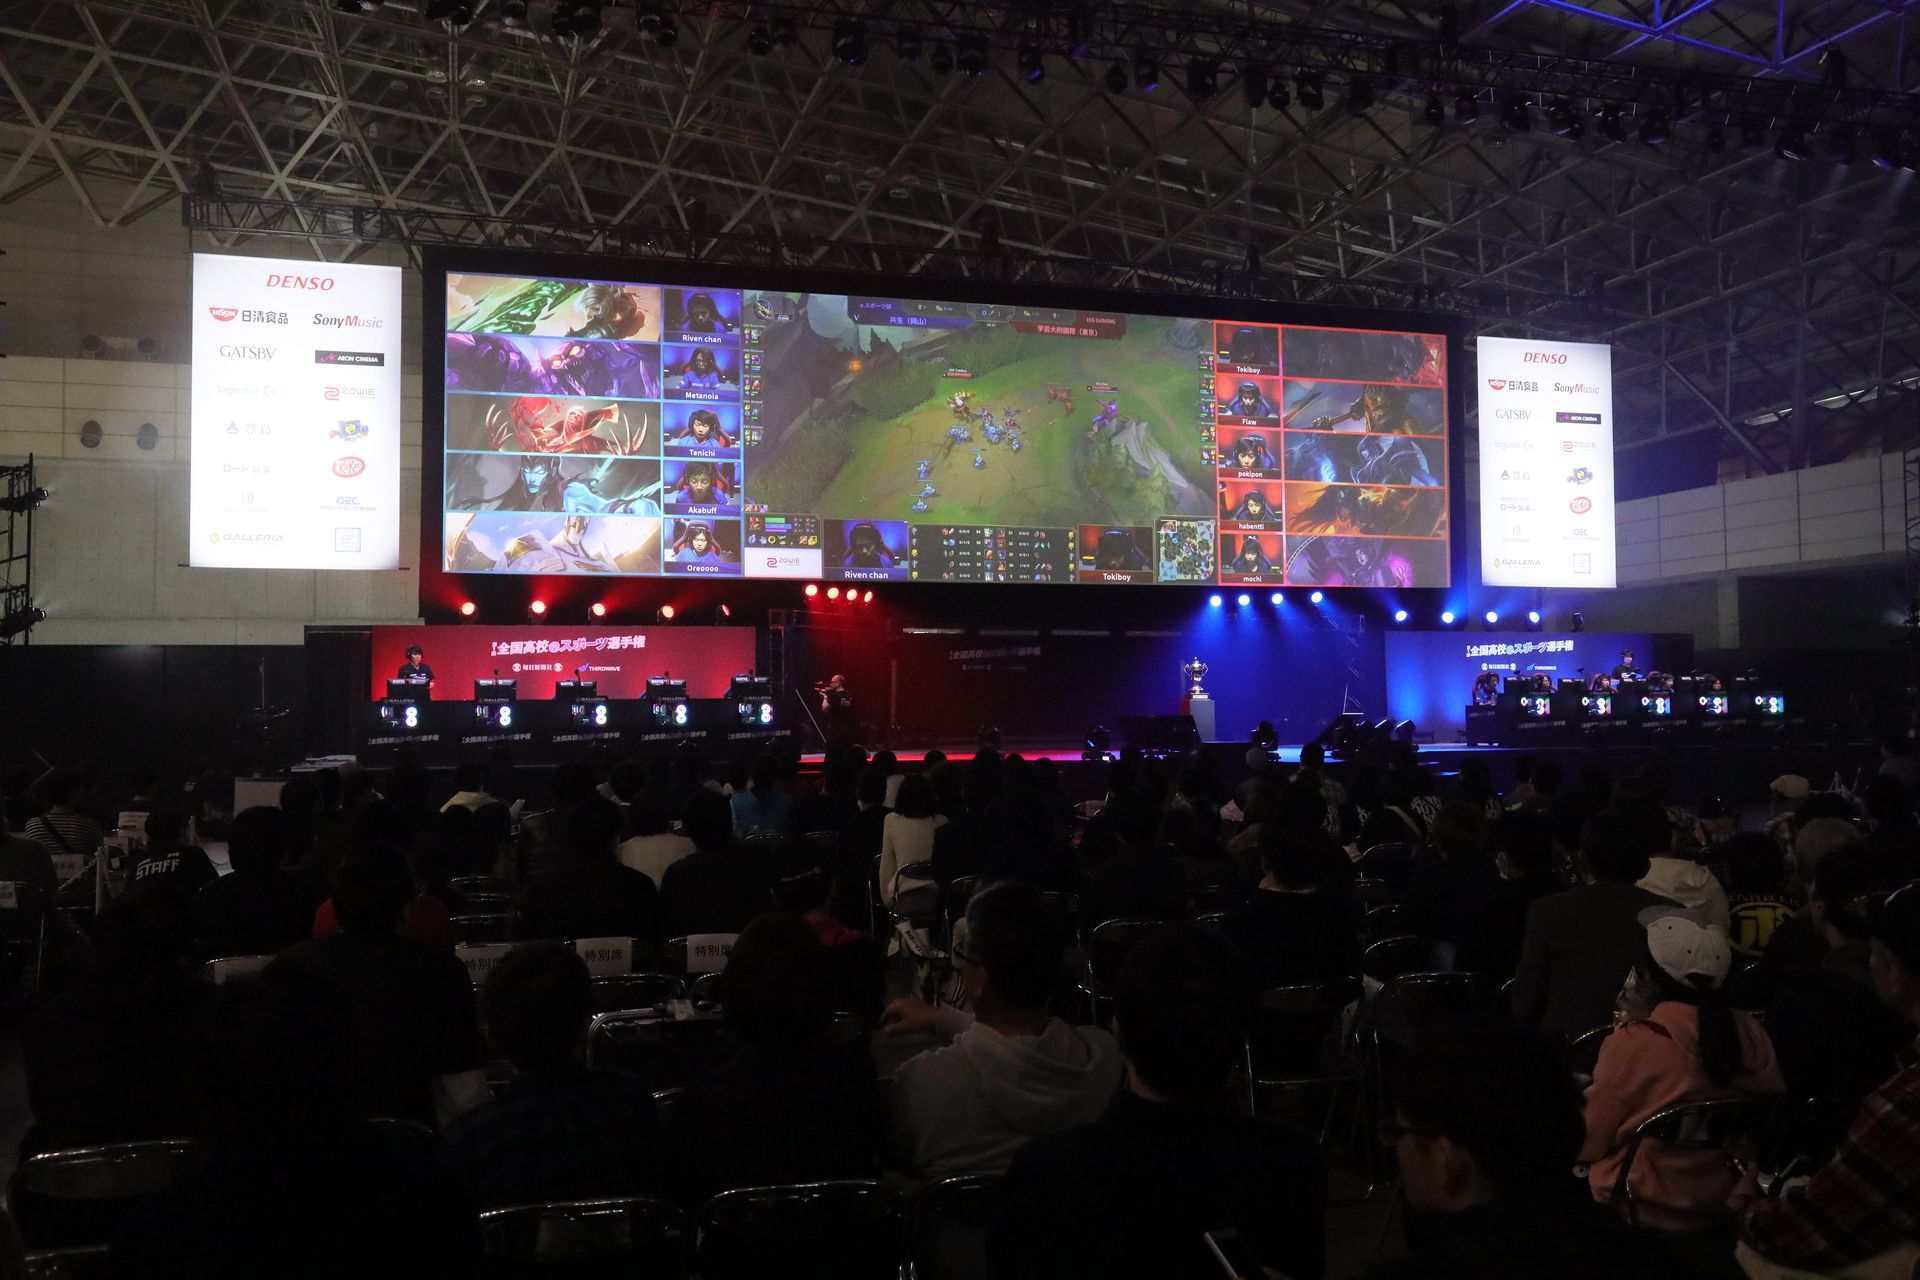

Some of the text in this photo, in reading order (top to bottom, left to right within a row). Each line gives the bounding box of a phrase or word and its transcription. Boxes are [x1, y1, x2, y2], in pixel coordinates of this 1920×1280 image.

[266, 274, 334, 291] DENSO
[242, 310, 288, 324] 日清食品
[682, 334, 722, 343] Riven chan
[220, 345, 277, 361] GATSBY
[1524, 352, 1568, 364] DENSO
[1236, 366, 1260, 374] Tokiboy
[1508, 380, 1538, 392] 日清食品
[342, 387, 374, 396] ZOWIE
[686, 392, 718, 400] Metanoia
[1495, 408, 1532, 421] GATSBY
[689, 449, 716, 457] Tenichi
[1238, 470, 1263, 478] pokipon
[688, 506, 717, 514] Akabuff
[222, 533, 283, 542] GALLERIA
[869, 571, 889, 579] chan
[1103, 573, 1131, 582] Tokiboy
[136, 858, 180, 880] STAFF
[585, 950, 623, 961] 特別席
